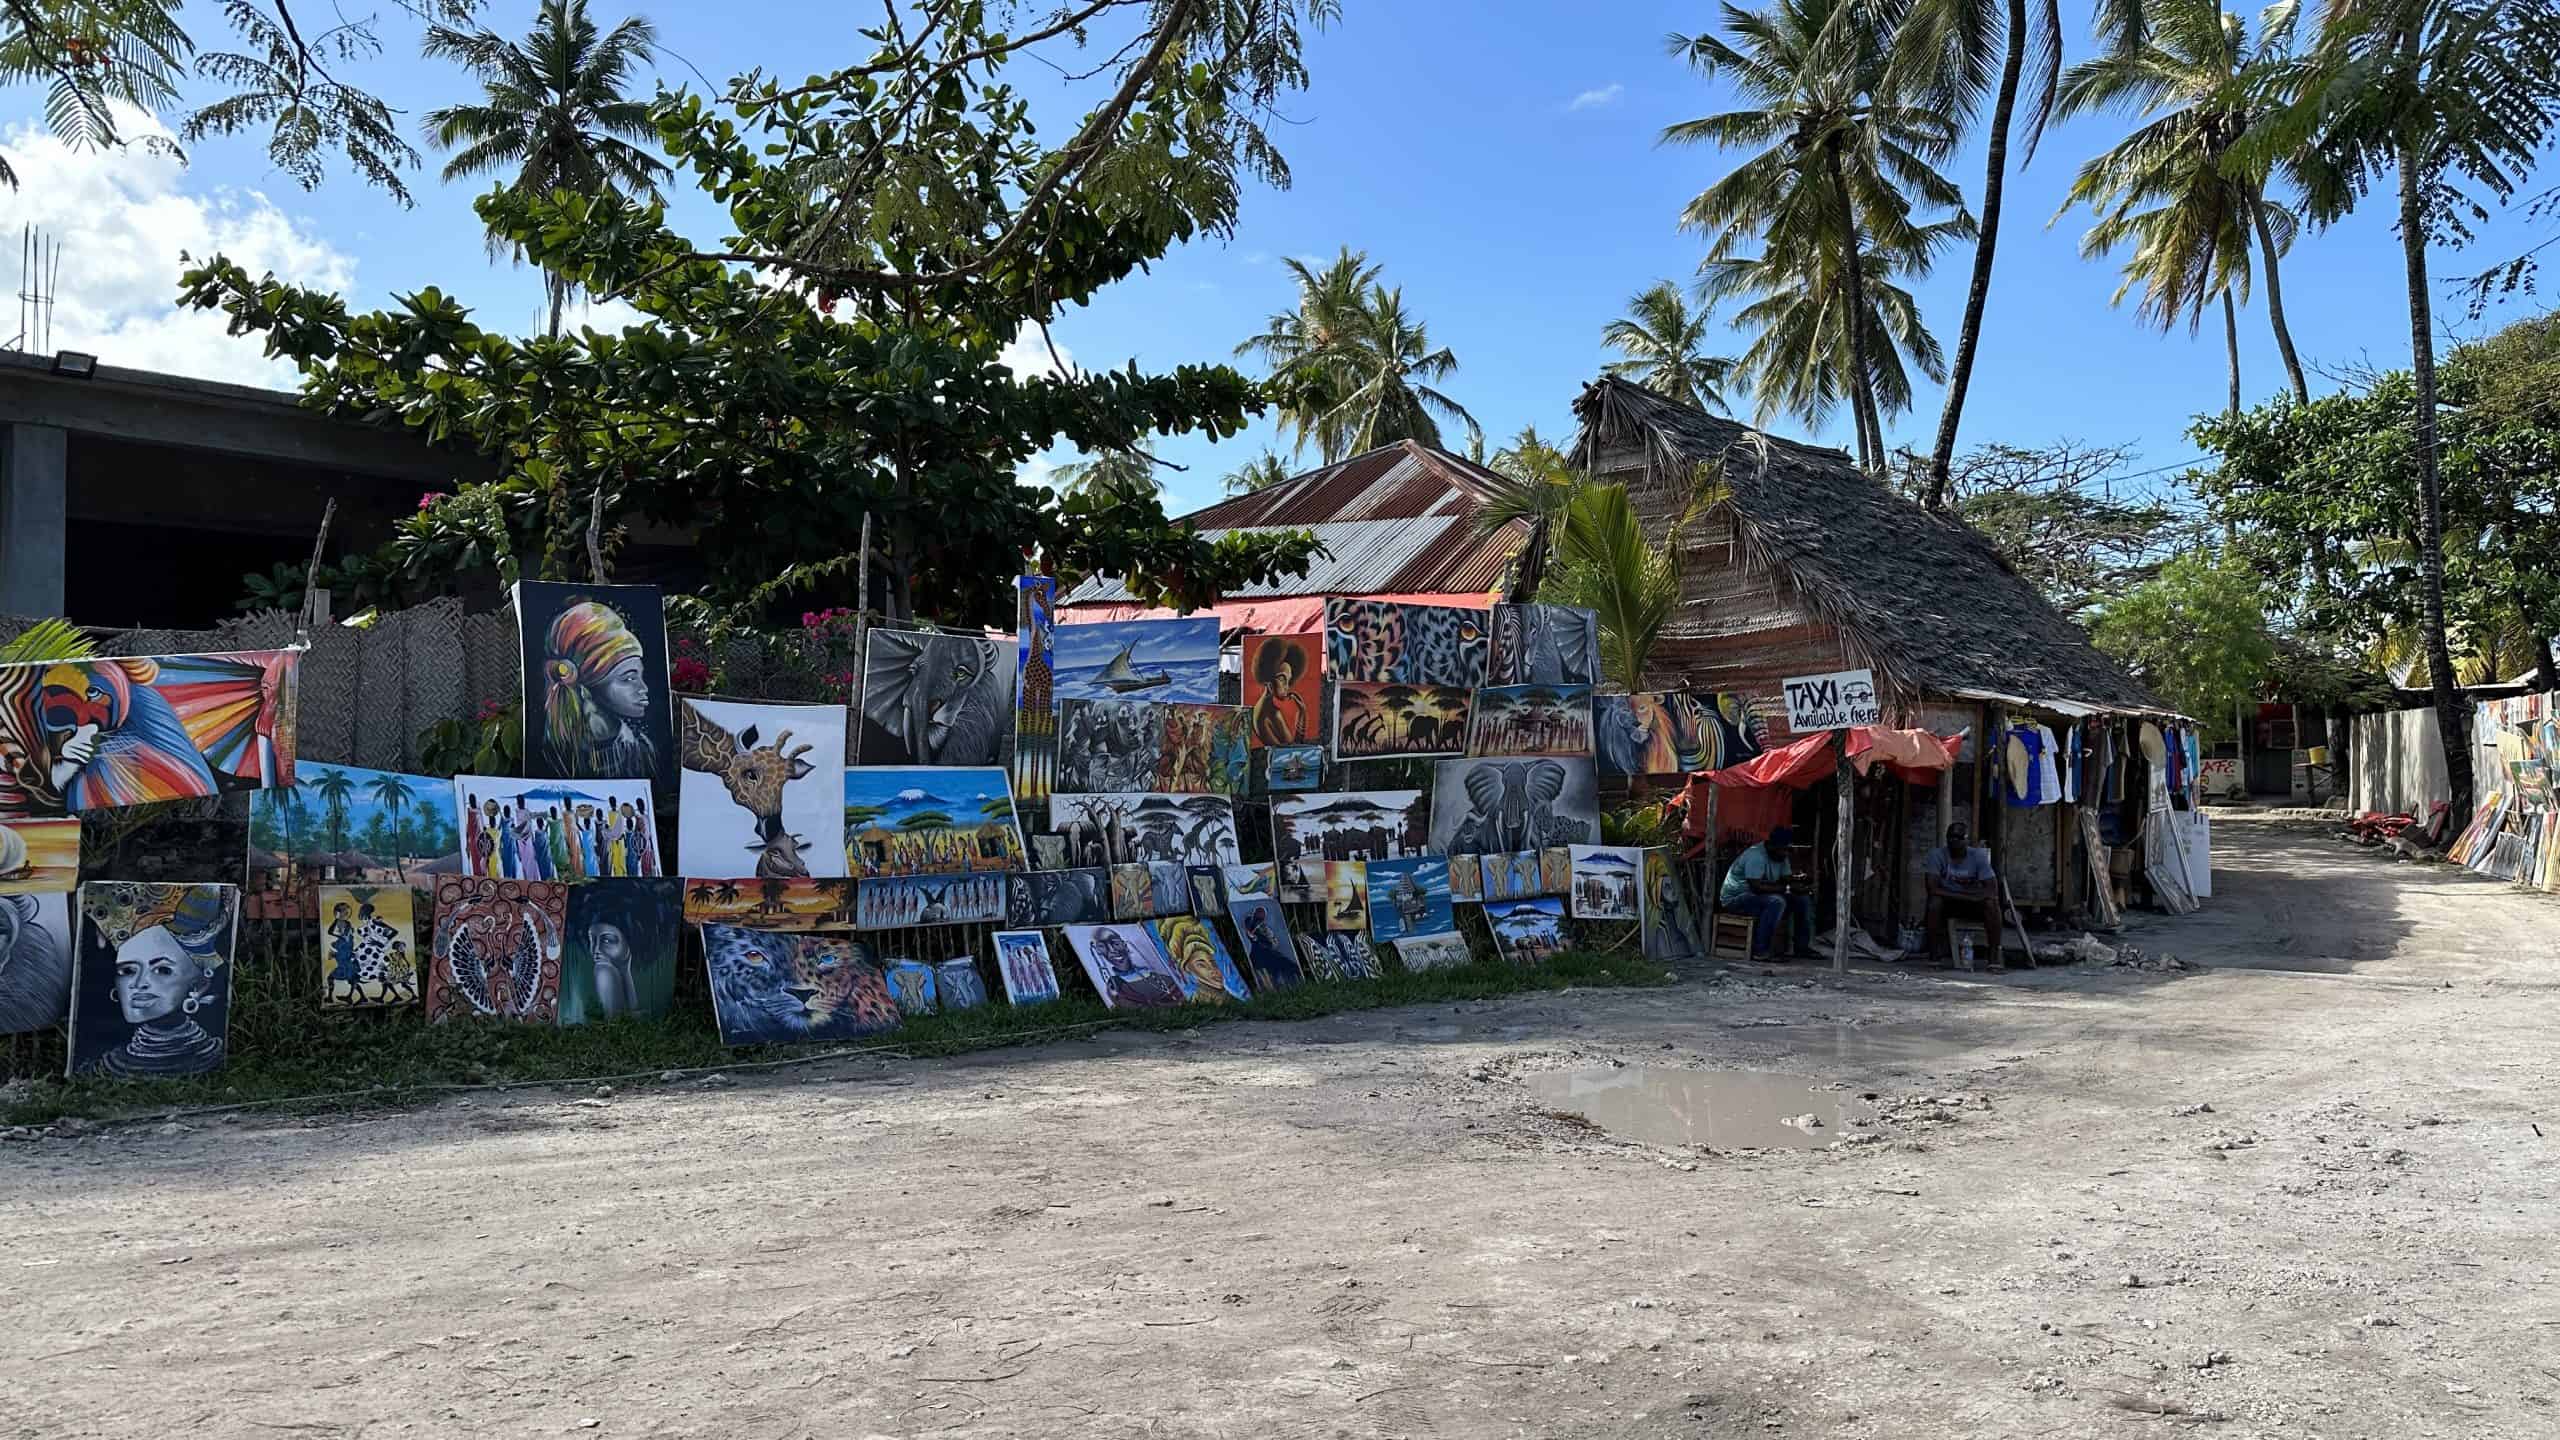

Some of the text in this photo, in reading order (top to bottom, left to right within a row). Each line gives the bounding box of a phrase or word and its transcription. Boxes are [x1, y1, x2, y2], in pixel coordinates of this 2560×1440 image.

[1785, 680, 1839, 711] TAXI
[1851, 705, 1880, 723] here
[2200, 759, 2235, 774] AFE
